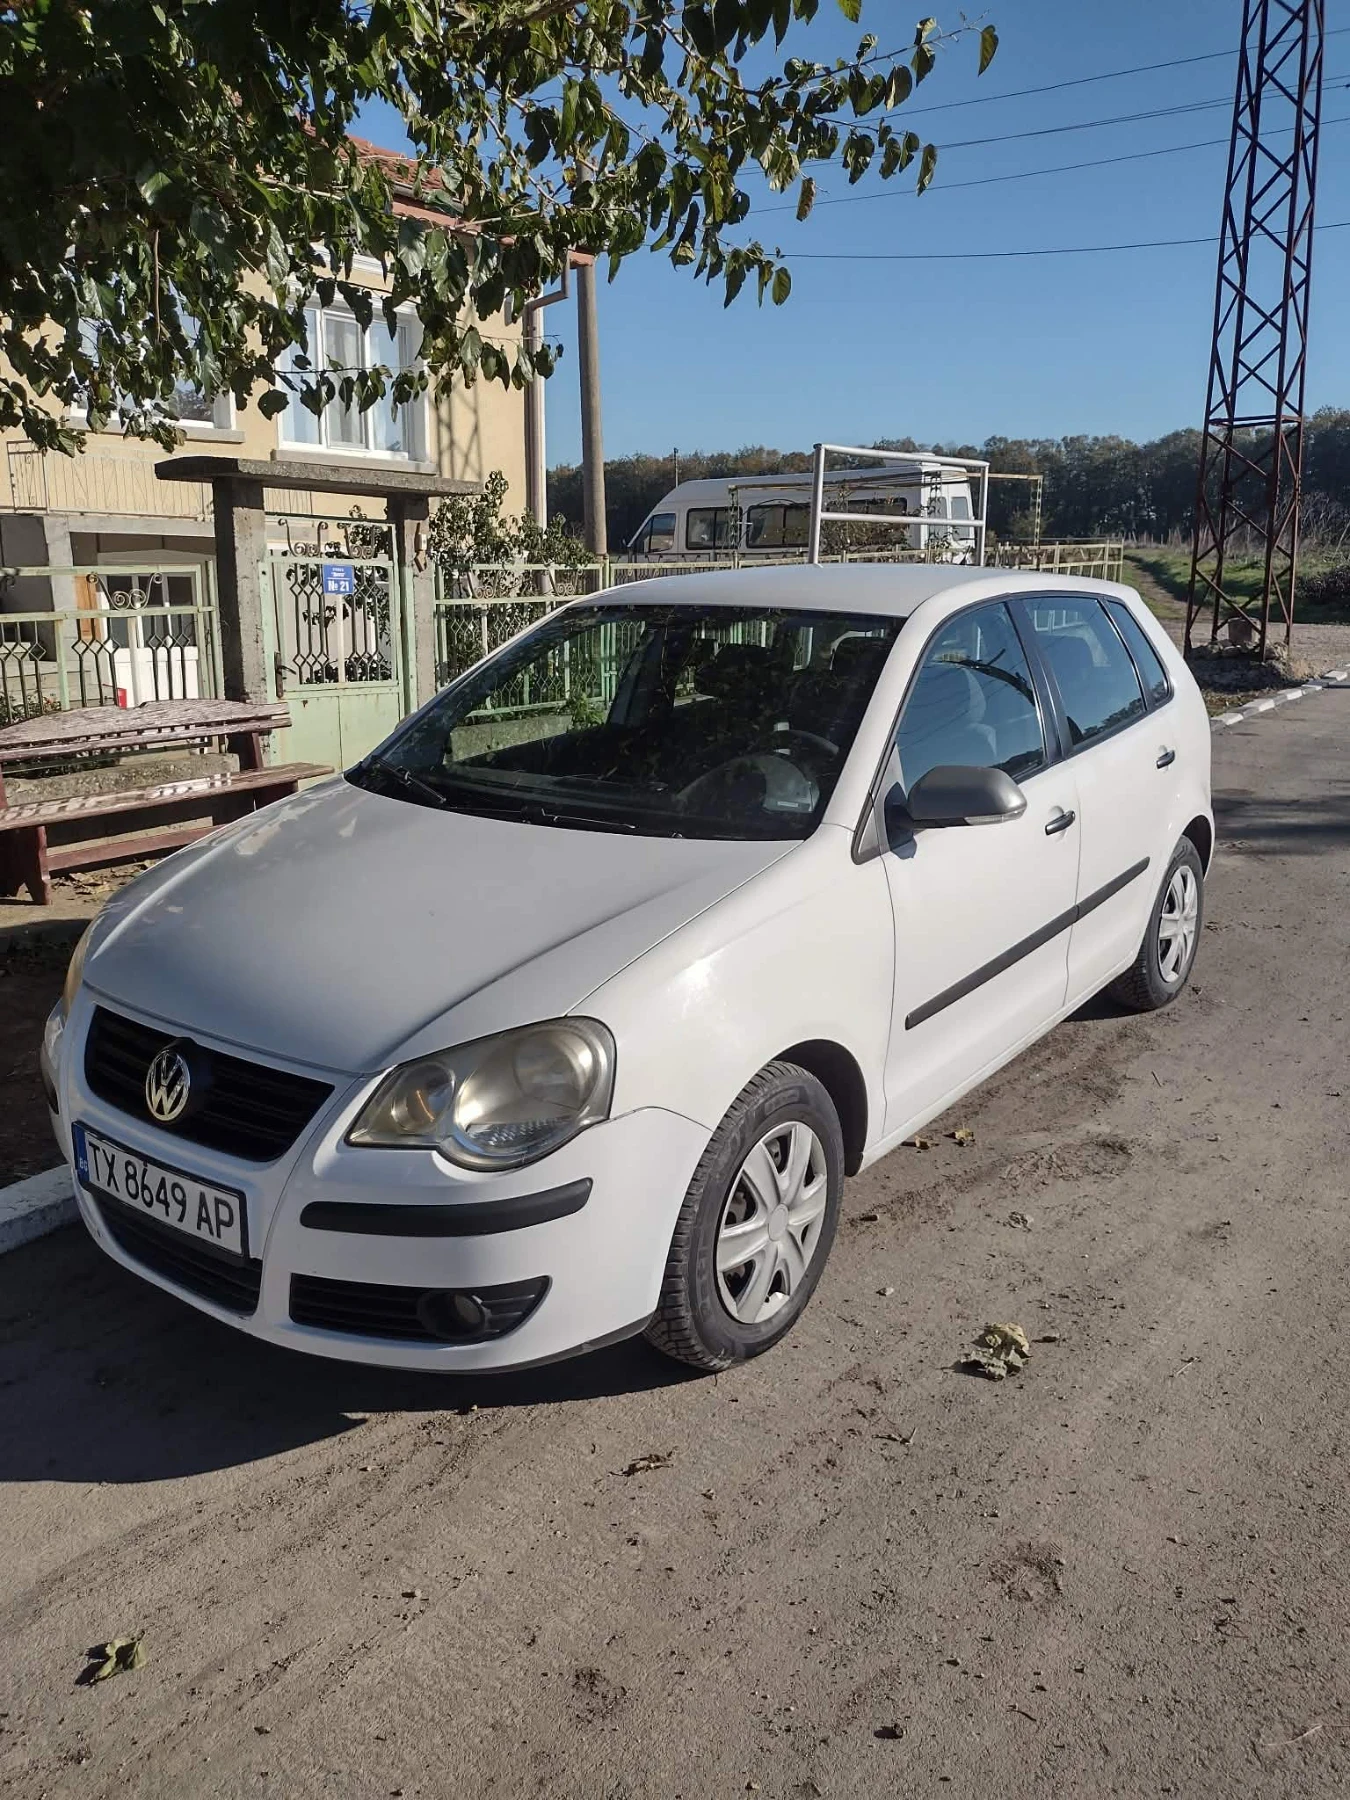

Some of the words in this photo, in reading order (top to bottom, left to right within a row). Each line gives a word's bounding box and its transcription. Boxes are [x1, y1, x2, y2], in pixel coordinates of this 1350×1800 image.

[340, 580, 350, 591] 21
[146, 1050, 190, 1120] VW
[88, 1140, 120, 1192] TX
[124, 1159, 187, 1223] 8649
[196, 1191, 234, 1239] AP
